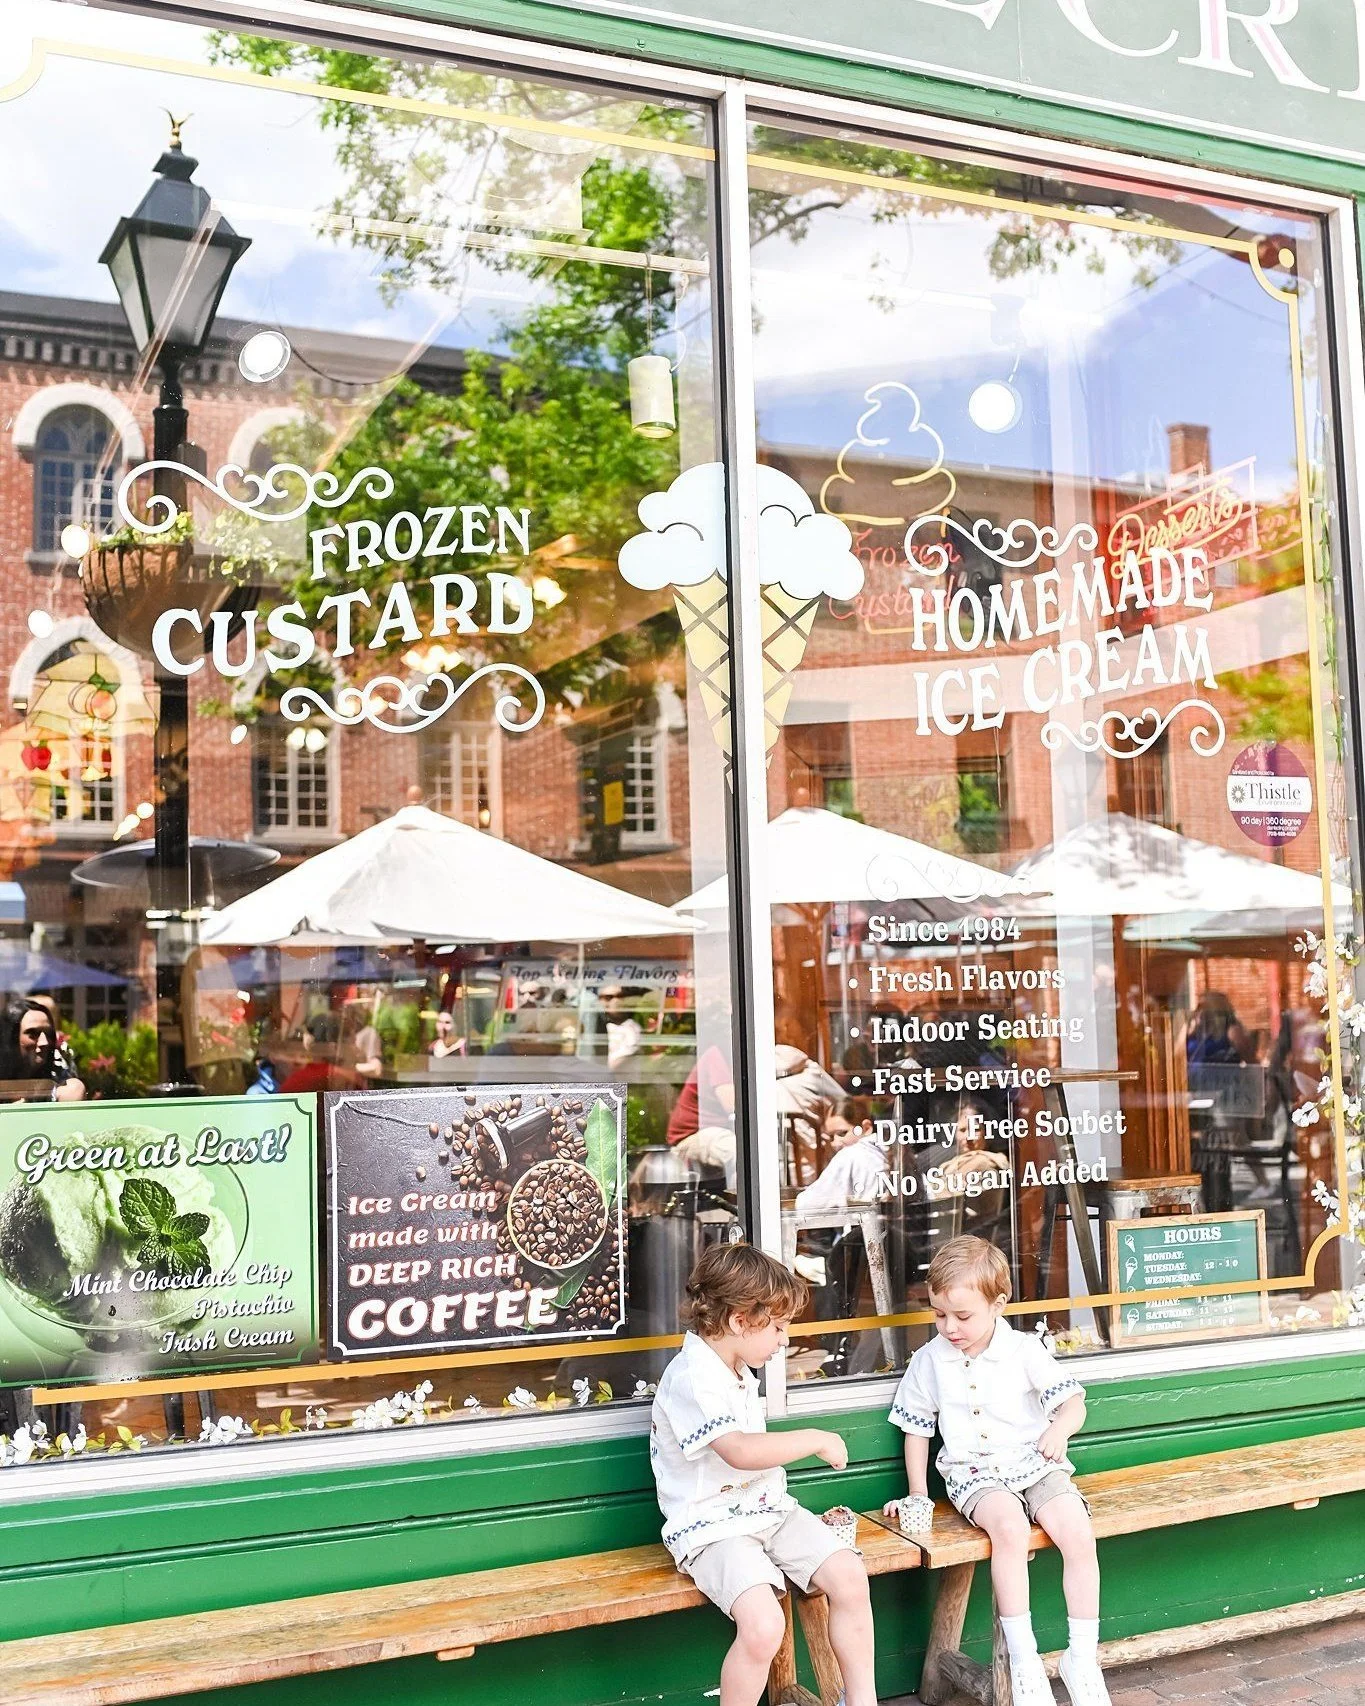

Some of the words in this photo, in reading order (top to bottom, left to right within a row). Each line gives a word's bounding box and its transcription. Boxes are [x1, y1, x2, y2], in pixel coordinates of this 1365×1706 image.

[309, 503, 531, 581] FROZEN
[1107, 477, 1243, 579] Desserts
[909, 549, 1214, 652] HOMEMADE
[151, 571, 534, 677] CUSTARD
[913, 663, 1006, 736] ICE
[1023, 624, 1218, 713] CREAM
[1246, 783, 1301, 799] Thistle
[1241, 817, 1250, 825] 90
[1251, 817, 1262, 826] day
[1279, 817, 1301, 826] degree
[868, 915, 948, 942] Since
[959, 916, 1021, 941] 1984
[510, 965, 540, 981] Top
[614, 965, 678, 981] Flavors
[869, 966, 954, 992] Fresh
[961, 965, 1065, 990] Flavors
[870, 1016, 969, 1043] Indoor
[978, 1013, 1084, 1041] Seating
[872, 1068, 937, 1095] Fast
[945, 1063, 1051, 1091] Service
[874, 1117, 958, 1148] Dairy
[966, 1114, 1029, 1139] Free
[1035, 1109, 1127, 1136] Sorbet
[17, 1133, 127, 1183] Green
[137, 1132, 181, 1167] at
[186, 1123, 292, 1166] Last!
[876, 1170, 917, 1197] No
[925, 1167, 1014, 1197] Sugar
[1021, 1157, 1109, 1187] Added
[348, 1196, 392, 1215] Ice
[400, 1190, 497, 1214] Cream
[348, 1226, 429, 1248] made
[437, 1220, 498, 1242] with
[1163, 1226, 1222, 1244] HOURS
[348, 1259, 432, 1287] DEEP
[441, 1254, 518, 1280] RICH
[1143, 1250, 1185, 1262] MONDAY:
[1144, 1262, 1187, 1274] TUESDAY:
[1204, 1261, 1215, 1270] 12
[63, 1273, 122, 1297] Mint
[129, 1267, 237, 1292] Chocolate
[242, 1263, 293, 1289] Chip
[1144, 1273, 1202, 1285] WEDNESDAY:
[191, 1295, 295, 1321] Pistachio
[347, 1287, 559, 1340] COFFEE
[159, 1331, 218, 1354] Irish
[224, 1326, 295, 1349] Cream
